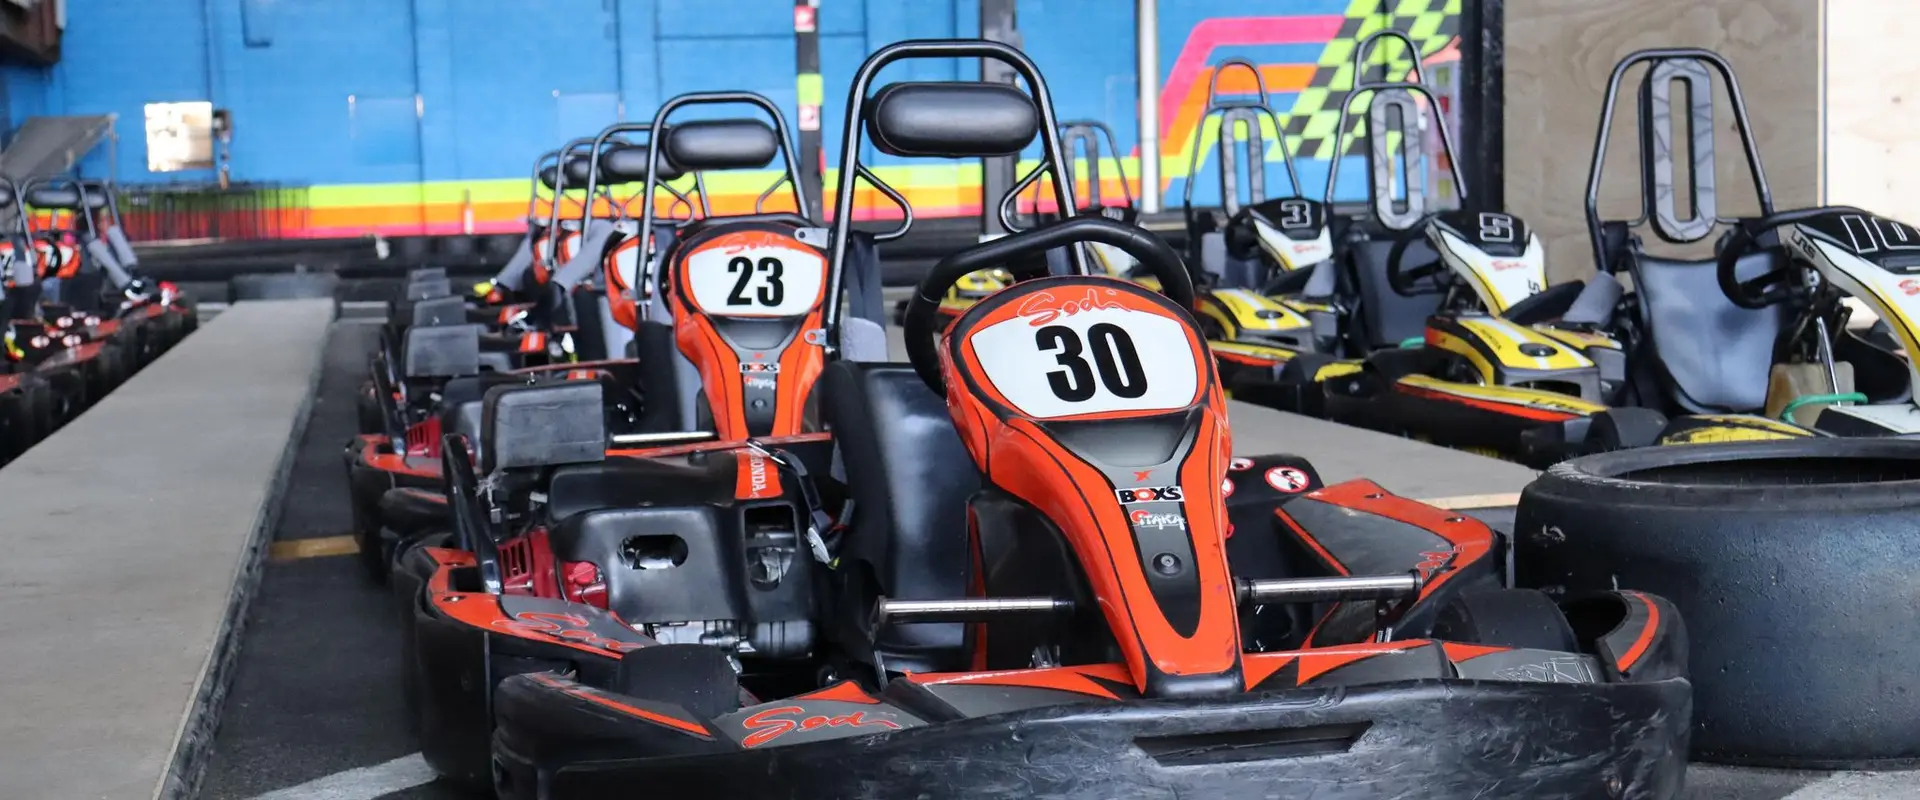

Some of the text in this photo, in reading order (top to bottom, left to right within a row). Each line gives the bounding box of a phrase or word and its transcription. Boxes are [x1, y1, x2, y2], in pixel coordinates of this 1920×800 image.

[1281, 200, 1312, 229] 3
[1479, 212, 1514, 243] 5
[727, 256, 784, 307] 23
[1016, 288, 1131, 326] Sodi
[1035, 322, 1148, 402] 30
